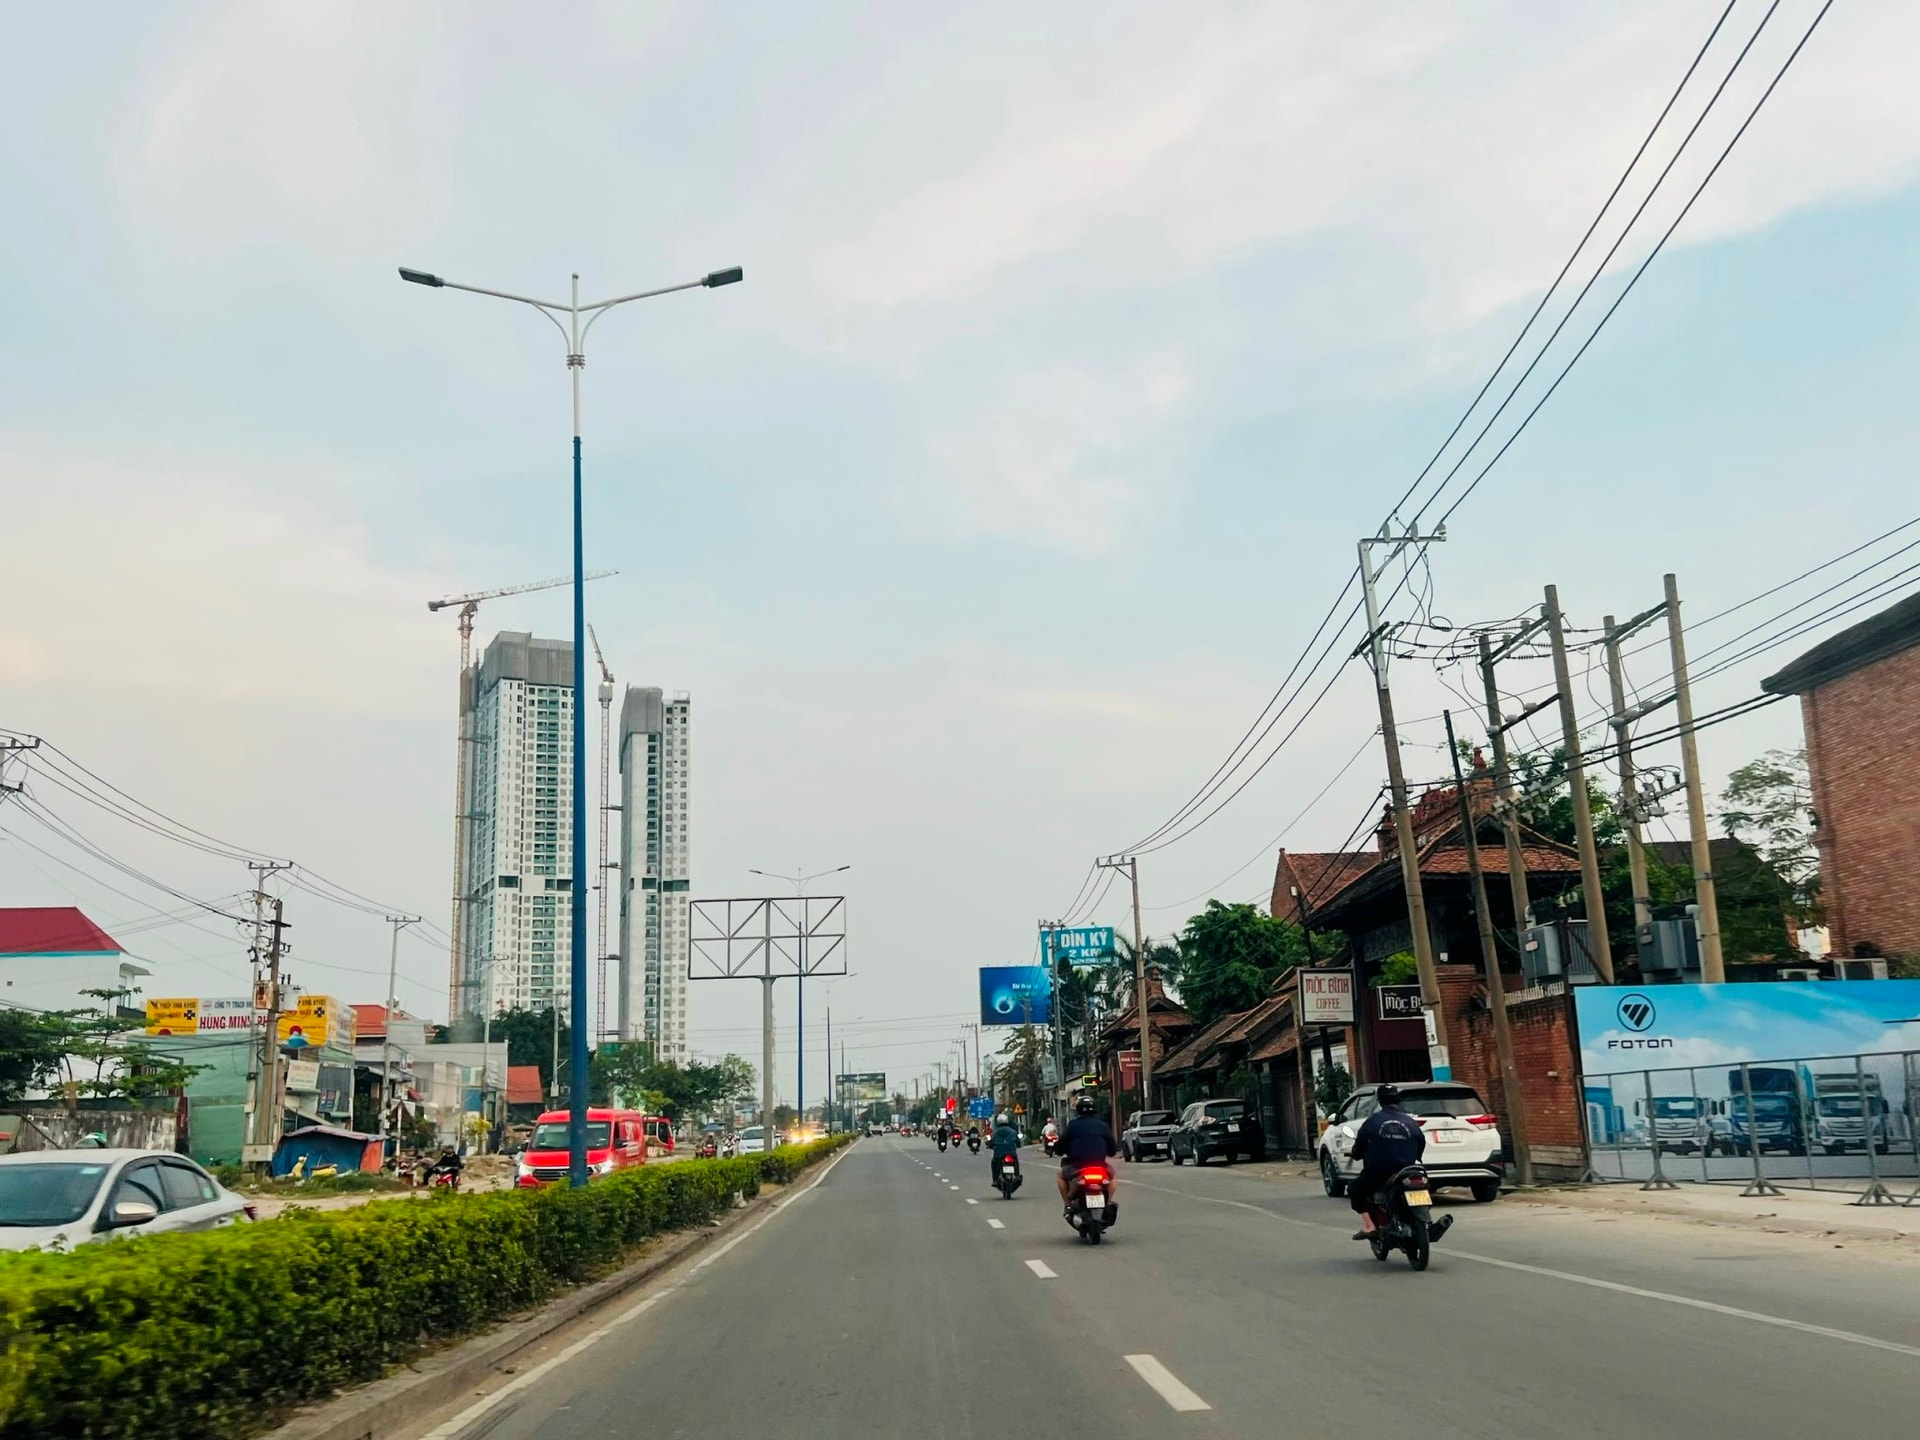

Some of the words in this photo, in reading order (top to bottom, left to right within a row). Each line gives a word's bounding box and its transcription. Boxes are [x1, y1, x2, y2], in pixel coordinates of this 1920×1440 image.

[1061, 930, 1086, 948] DÌN
[1068, 949, 1077, 958] 2
[1316, 998, 1341, 1009] COFFEE
[200, 1013, 226, 1029] HÙNG
[1607, 1038, 1673, 1050] FOTON
